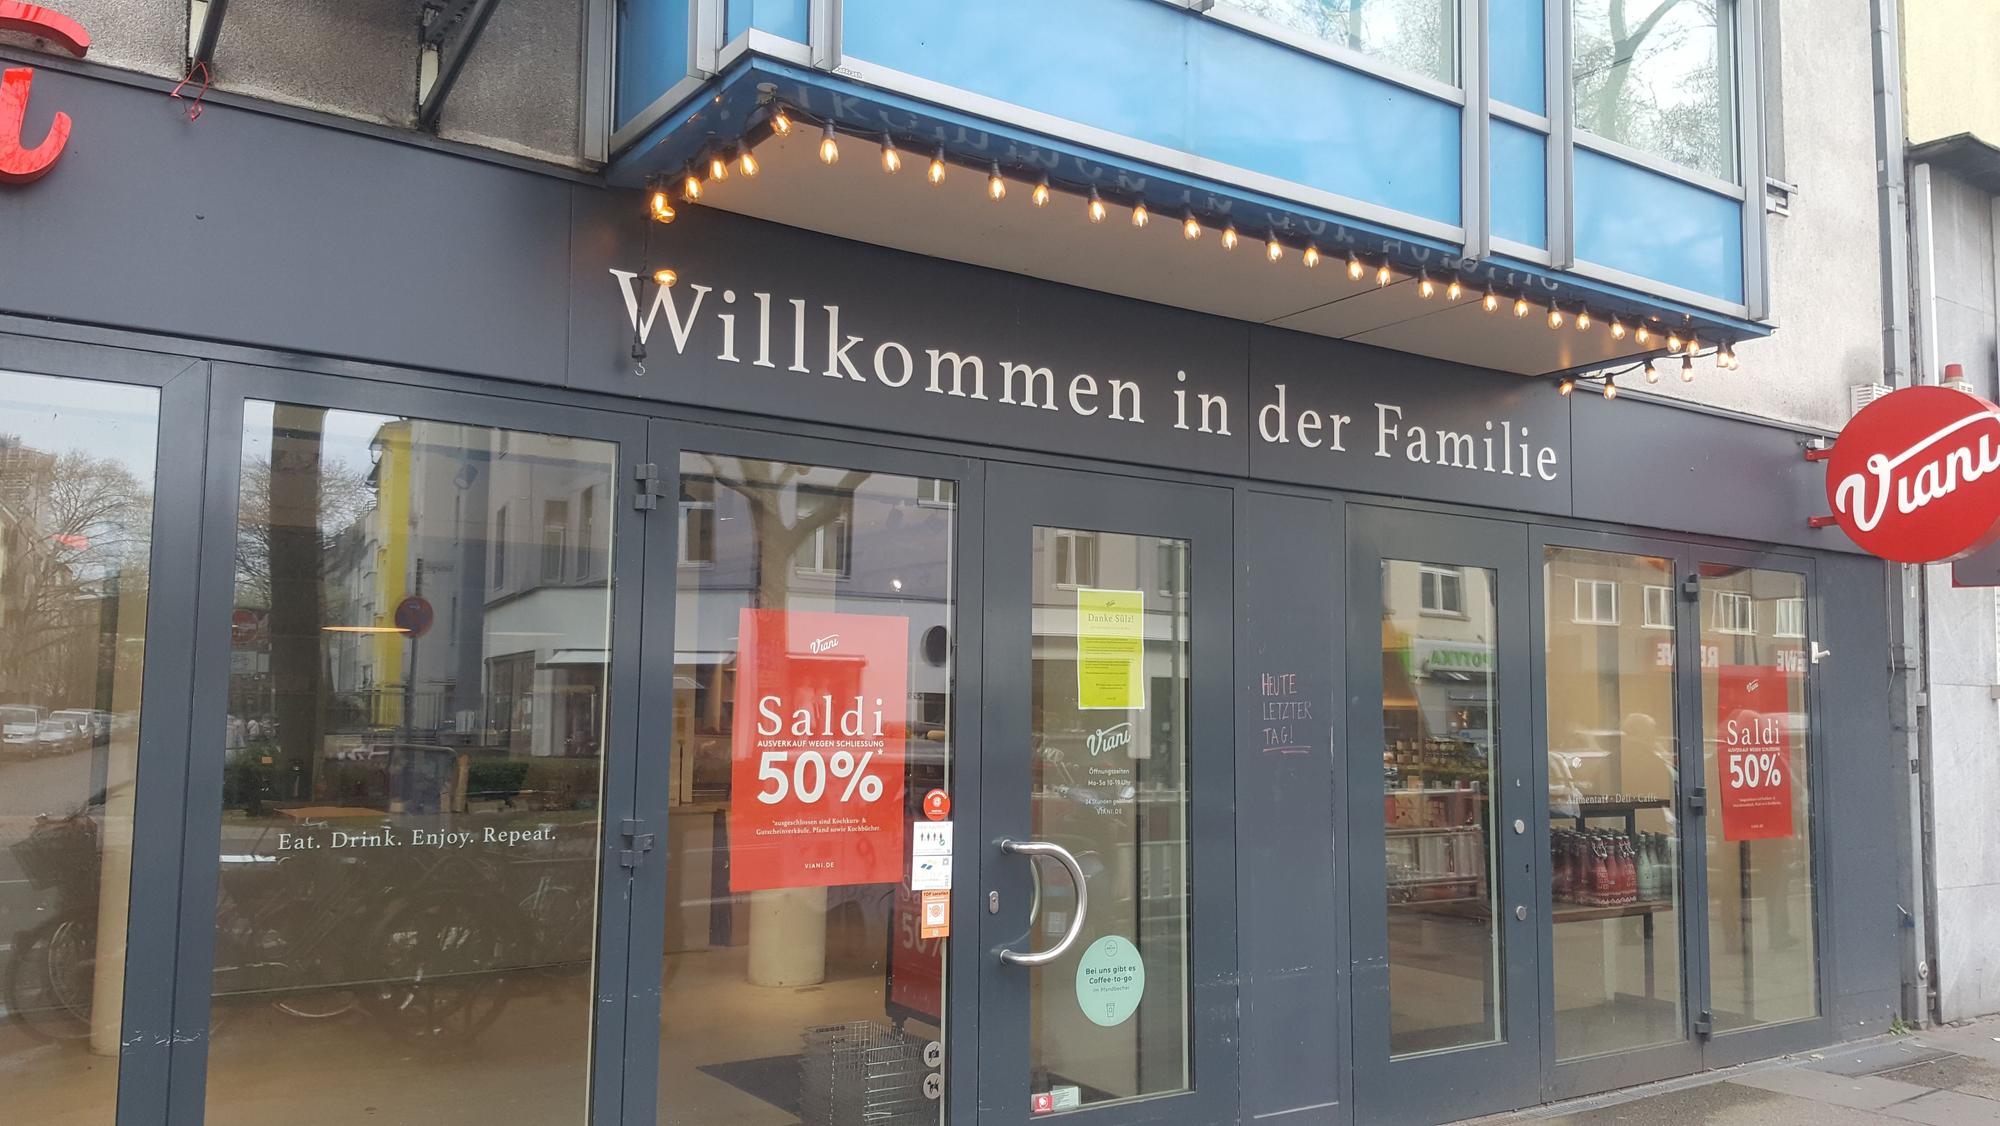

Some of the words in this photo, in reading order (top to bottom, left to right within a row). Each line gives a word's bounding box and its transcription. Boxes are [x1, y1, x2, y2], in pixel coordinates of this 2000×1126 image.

[609, 268, 1145, 424] Willkommen
[1173, 371, 1232, 436] in
[1259, 383, 1351, 454] der
[1375, 402, 1559, 482] Familie
[1835, 410, 2000, 532] Viani
[1088, 613, 1113, 623] Danke
[810, 634, 840, 655] Viani
[1261, 672, 1298, 697] HEUTE
[757, 694, 885, 737] Saldi
[1263, 701, 1313, 721] LETZTER
[1086, 722, 1132, 756] Viani
[1262, 724, 1294, 745] TAG!
[1727, 718, 1781, 746] Saldi
[757, 740, 807, 748] AUSVERKAUF
[808, 740, 835, 748] WEGEN
[836, 740, 885, 748] SCHLIESSUNG
[278, 832, 321, 851] Eat.
[330, 830, 402, 849] Drink.
[412, 828, 475, 849] Enjoy.
[483, 826, 557, 848] Repeat.
[804, 861, 835, 869] VIANI.DE
[1085, 967, 1097, 975] Bei
[1098, 966, 1111, 974] uns
[1112, 965, 1127, 974] gibt
[1088, 975, 1133, 985] Coffee-to-go
